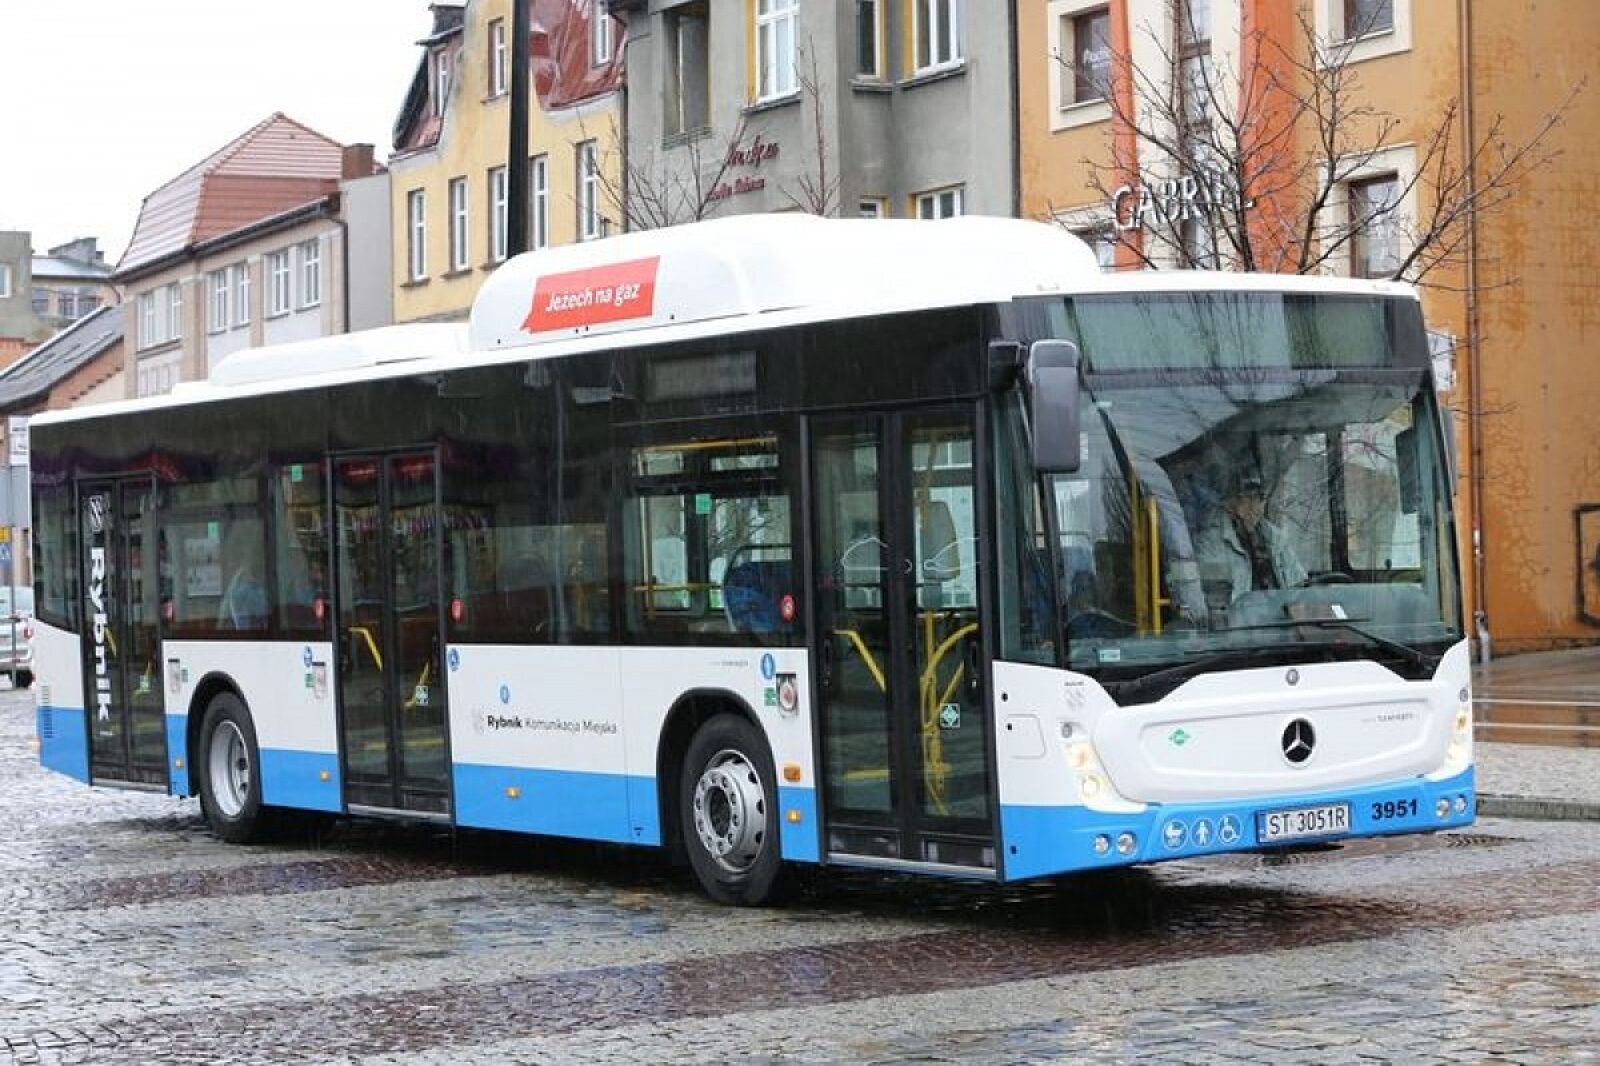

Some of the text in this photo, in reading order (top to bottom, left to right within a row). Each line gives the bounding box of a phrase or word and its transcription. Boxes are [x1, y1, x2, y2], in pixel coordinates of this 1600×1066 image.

[1115, 171, 1256, 228] GABRE
[595, 287, 614, 304] na
[615, 281, 641, 307] gaz
[89, 547, 112, 720] Rybnik
[487, 714, 522, 730] Rybnik
[1269, 806, 1345, 835] ST 3051R
[1371, 798, 1417, 820] 3951
